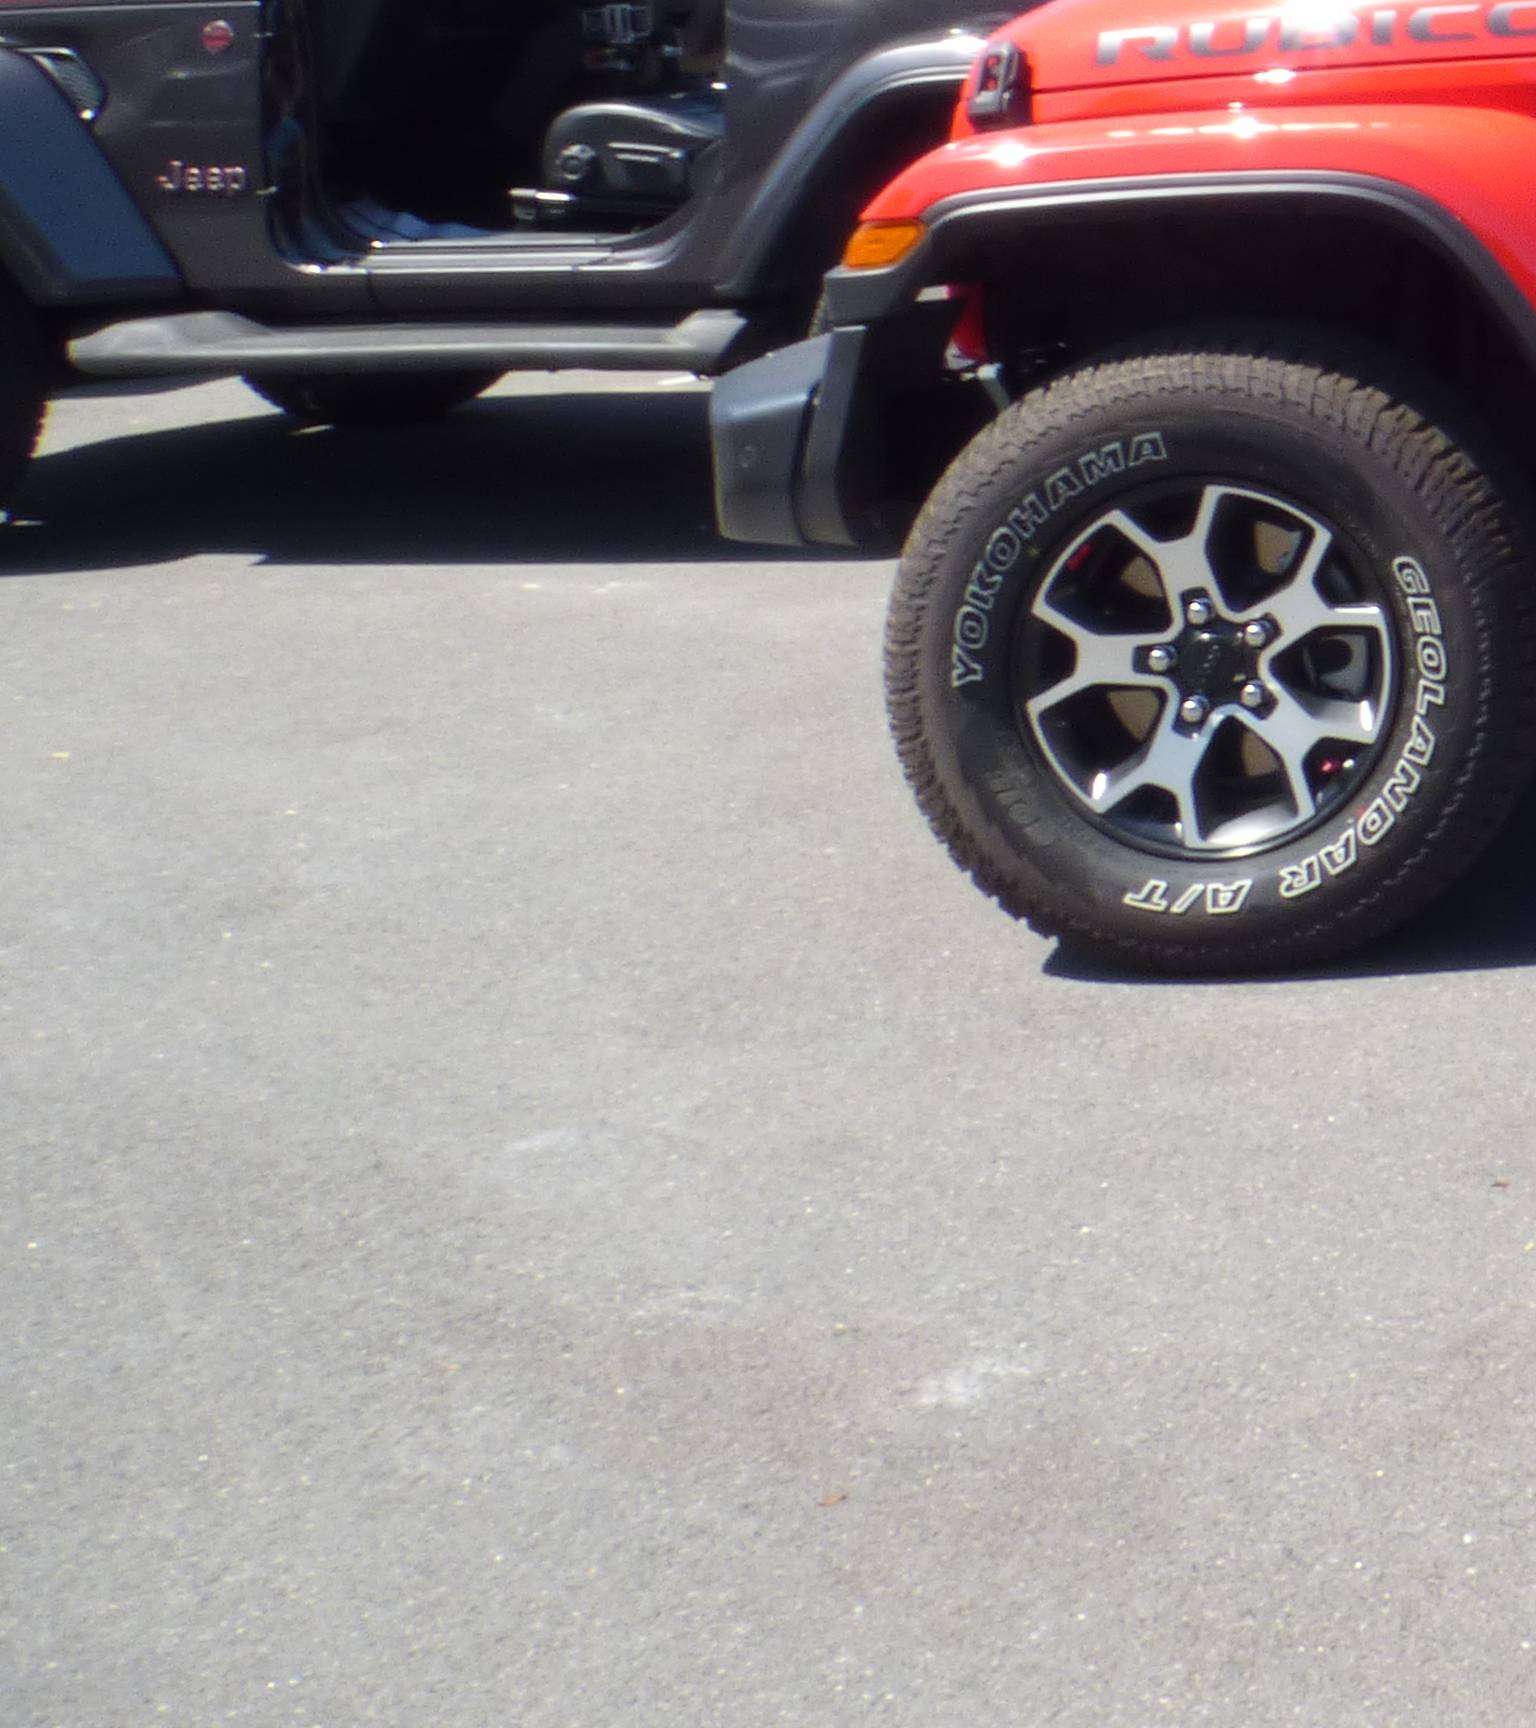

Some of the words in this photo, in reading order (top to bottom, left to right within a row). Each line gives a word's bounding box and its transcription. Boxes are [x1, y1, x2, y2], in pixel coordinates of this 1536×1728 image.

[157, 158, 246, 194] Jeep
[952, 432, 1168, 688] YOKOHAMA
[1278, 554, 1449, 899] GEOLANDAR
